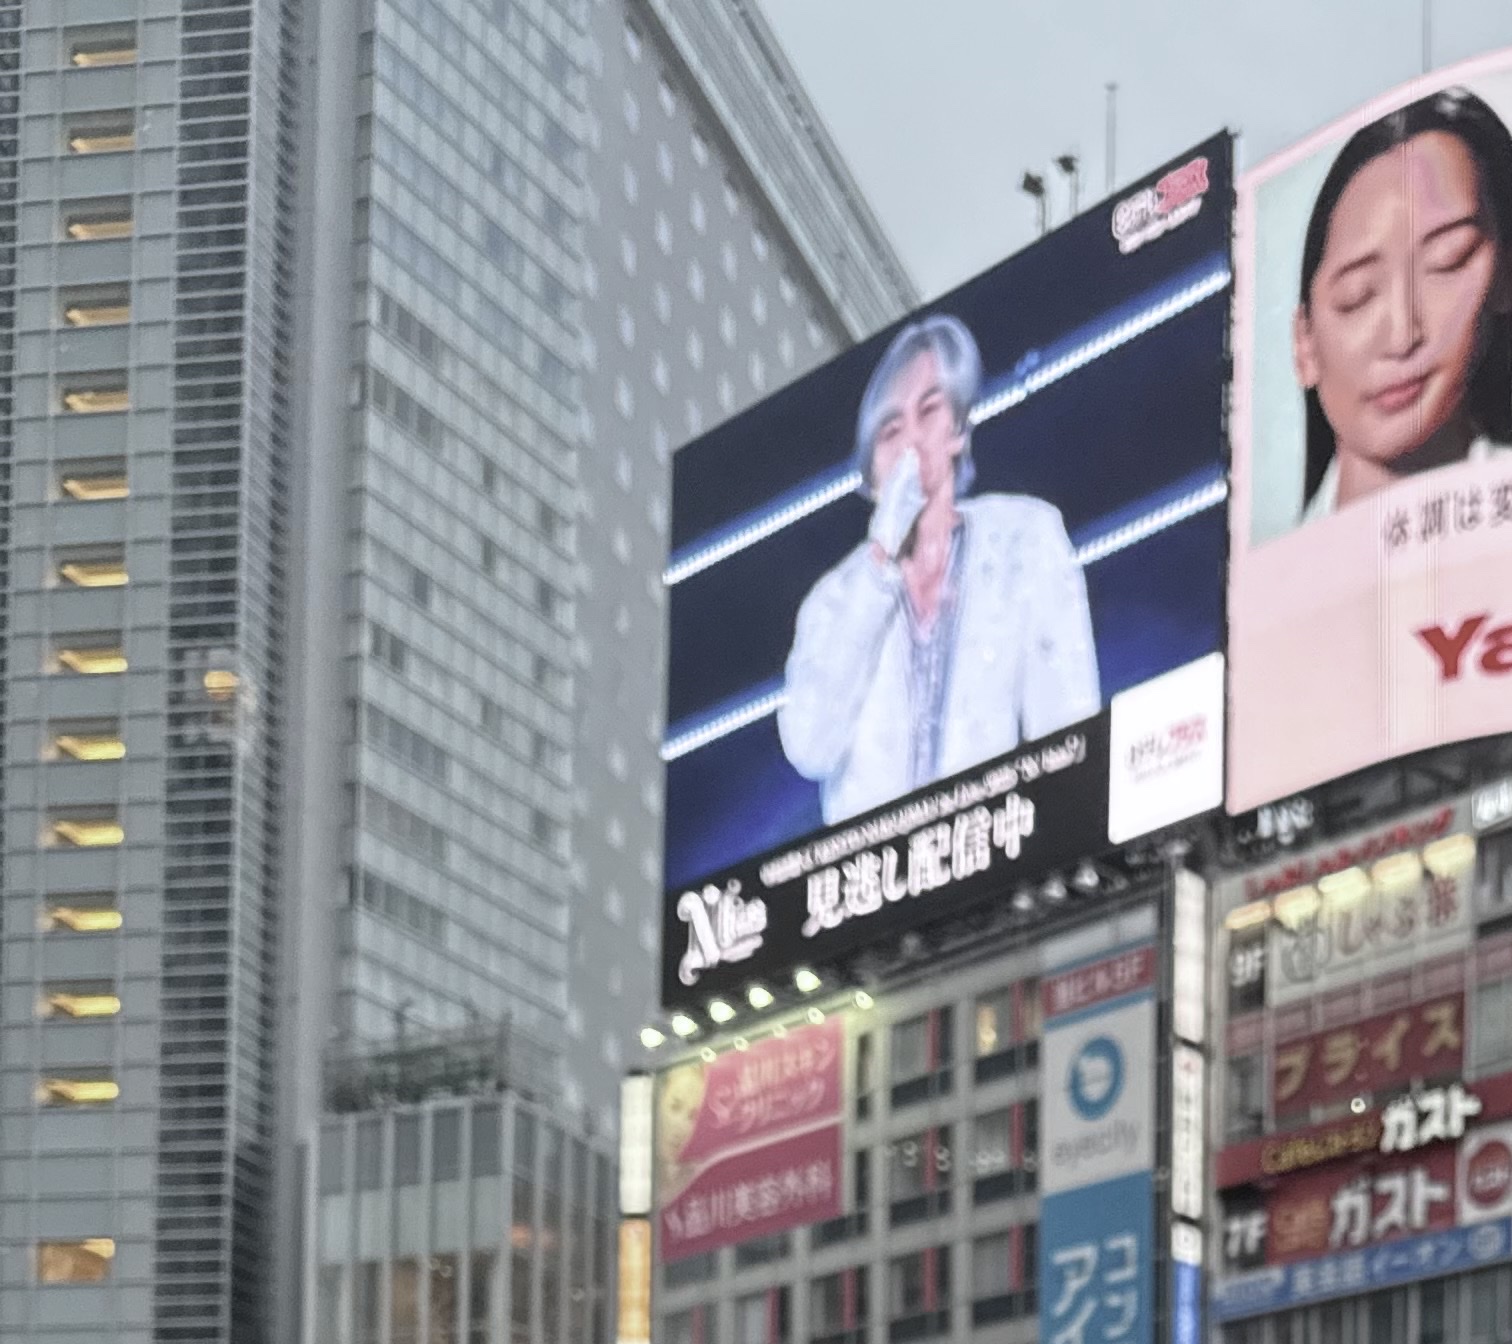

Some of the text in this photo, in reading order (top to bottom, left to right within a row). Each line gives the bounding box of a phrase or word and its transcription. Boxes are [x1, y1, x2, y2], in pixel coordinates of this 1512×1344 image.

[1379, 1084, 1483, 1153] ガスト
[1328, 1168, 1450, 1250] ガスト
